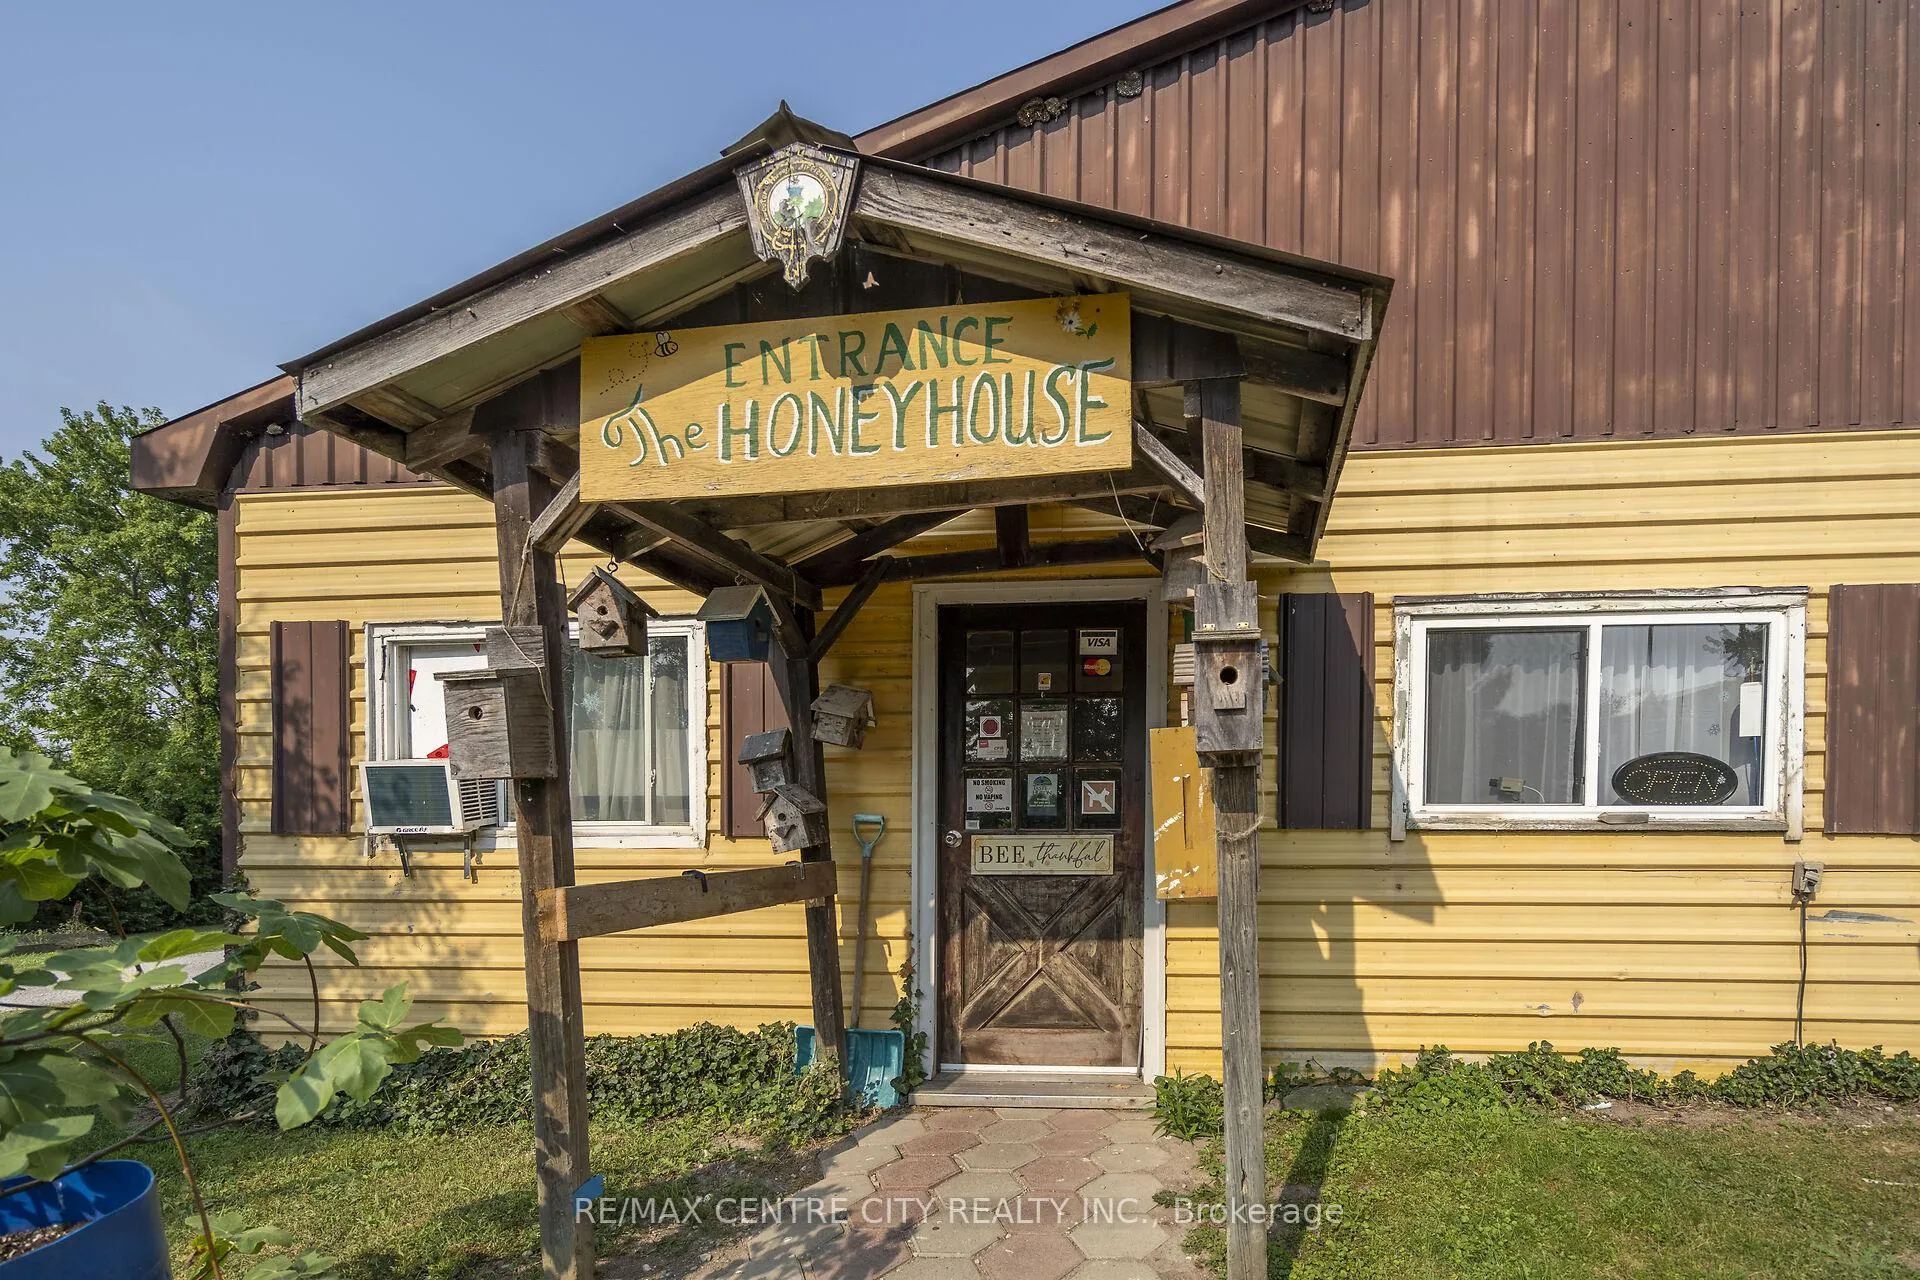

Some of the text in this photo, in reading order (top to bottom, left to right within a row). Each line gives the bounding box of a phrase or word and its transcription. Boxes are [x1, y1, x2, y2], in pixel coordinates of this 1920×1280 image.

[724, 316, 1014, 388] ENTRANCE
[601, 357, 1116, 467] The HONEYHOUSE
[1086, 637, 1111, 647] VISA
[1623, 769, 1723, 795] OPEN
[978, 840, 1106, 869] BEE thankful
